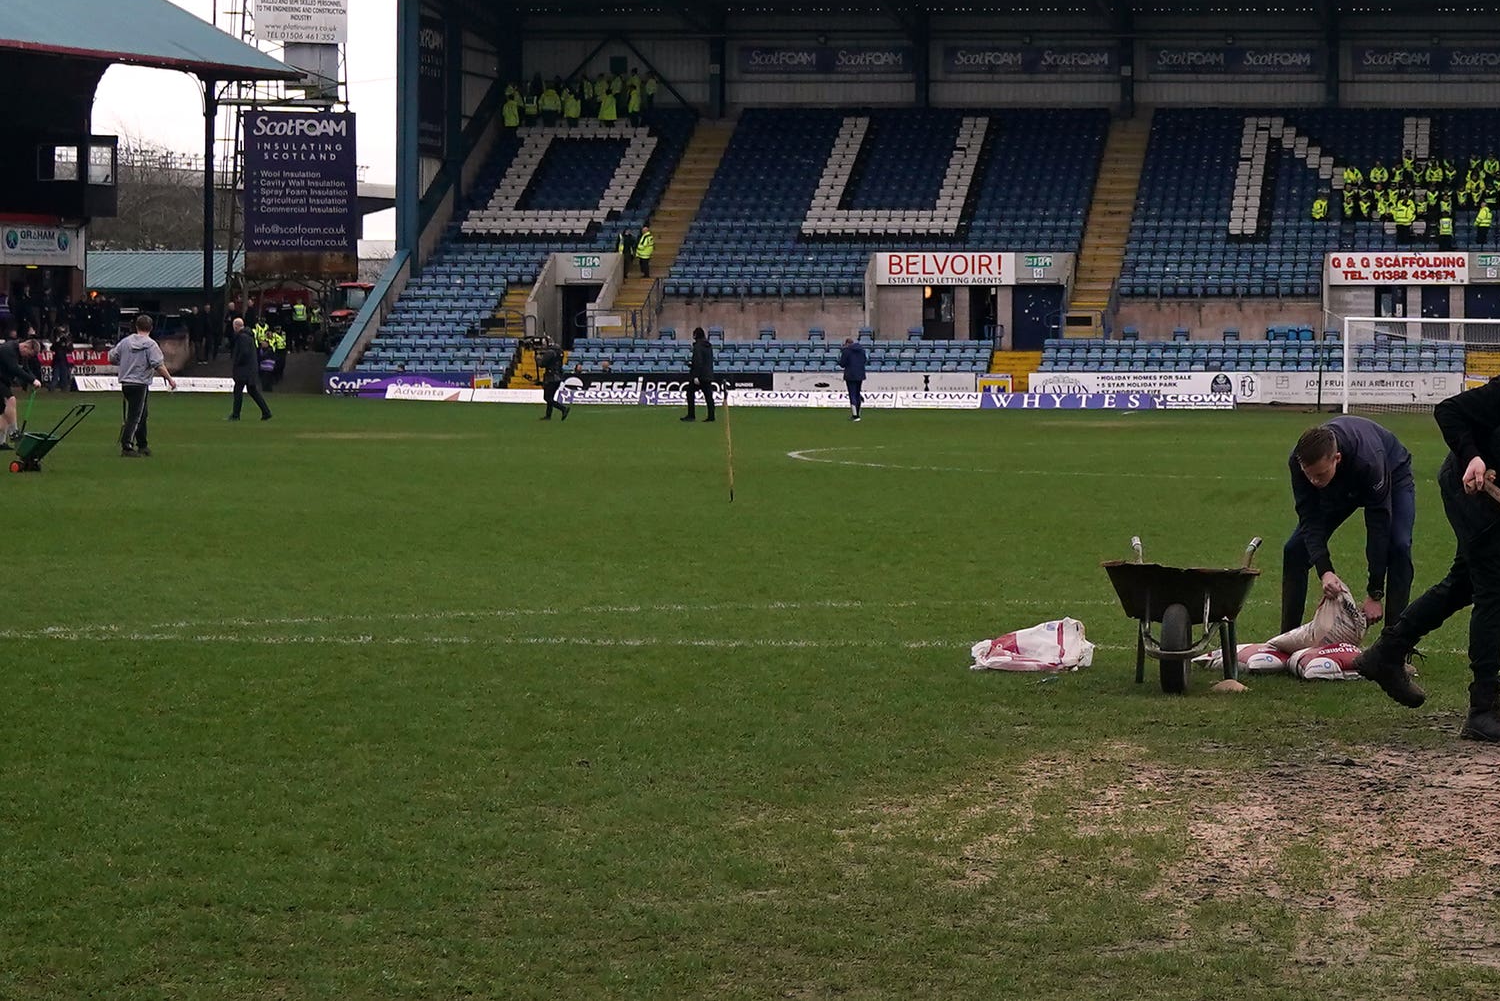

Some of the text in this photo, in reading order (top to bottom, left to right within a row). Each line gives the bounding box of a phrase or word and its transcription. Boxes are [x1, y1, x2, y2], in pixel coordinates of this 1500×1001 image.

[749, 50, 816, 66] ScotFOAM
[836, 50, 903, 66] ScotFOAM
[955, 51, 1021, 66] ScotFOAM
[1041, 51, 1108, 66] ScotFOAM
[1158, 50, 1224, 66] ScotFOAM
[1243, 50, 1310, 66] ScotFOAM
[1363, 51, 1430, 66] ScotFOAM
[253, 116, 347, 137] ScotFOAM
[257, 142, 343, 151] INSULATING
[263, 152, 337, 161] SCOTLAND
[283, 170, 321, 178] Insulation
[260, 179, 285, 187] Cavity
[308, 179, 345, 187] Insulation
[260, 188, 283, 197] Spray
[286, 188, 308, 196] Foam
[260, 205, 348, 214] Commercial Insulation
[254, 224, 346, 235] info@scotfoam.co.uk
[253, 237, 348, 247] www.scotfoam.co.uk
[888, 254, 1002, 275] BELVOIR!
[1331, 256, 1466, 268] G & G SCAFFOLDING
[1342, 270, 1368, 281] TEL.
[1372, 270, 1408, 281] 01382
[394, 387, 445, 397] Advanta
[574, 391, 639, 399] CROWN
[991, 394, 1141, 408] WHYTES
[1166, 394, 1234, 402] CROWN
